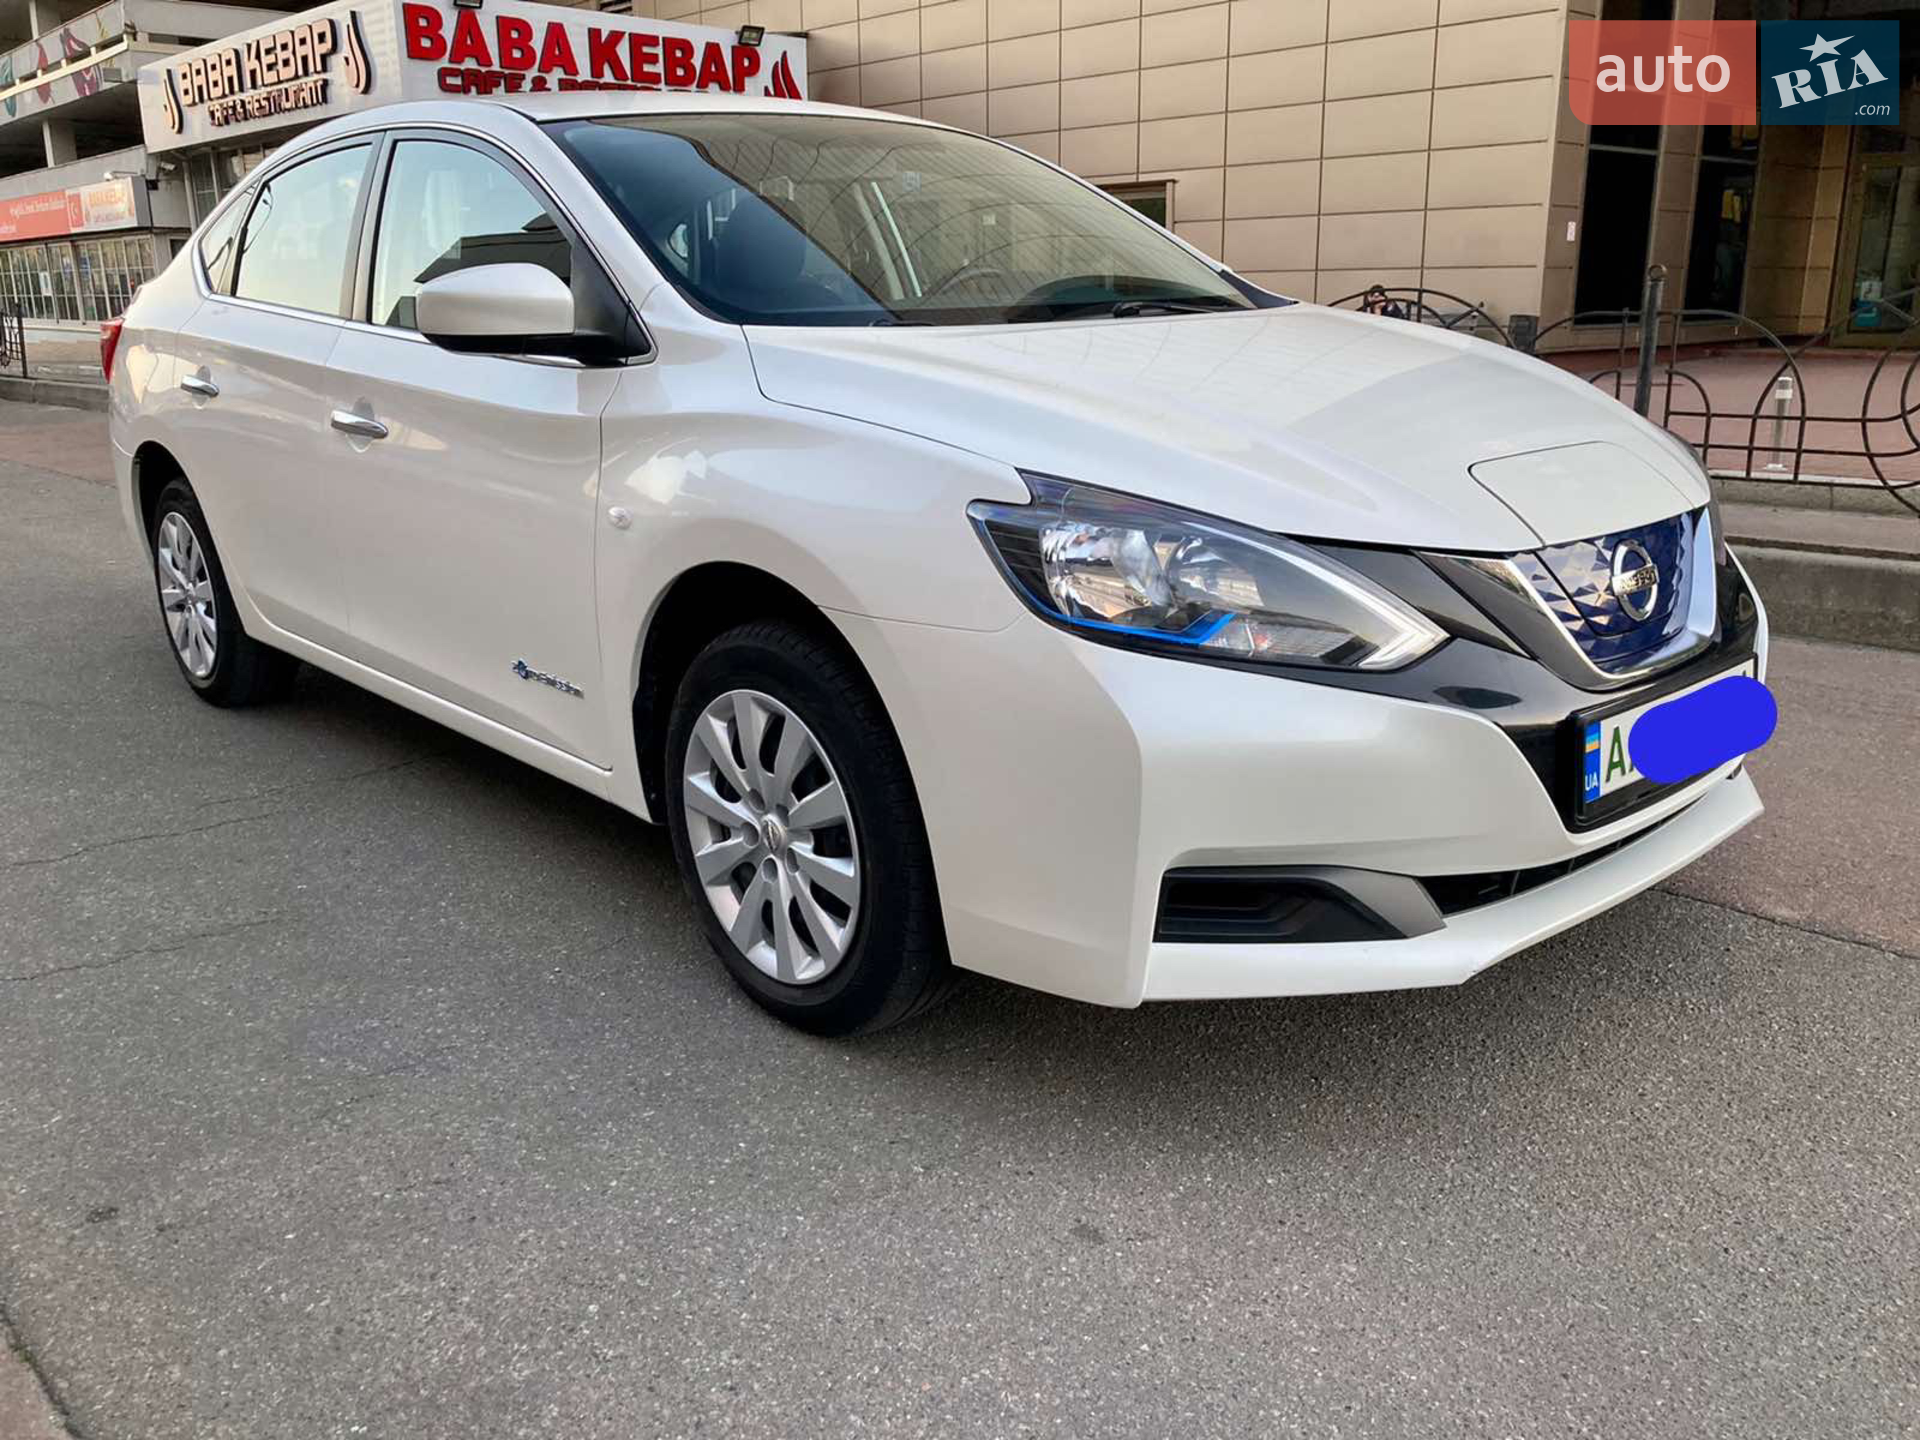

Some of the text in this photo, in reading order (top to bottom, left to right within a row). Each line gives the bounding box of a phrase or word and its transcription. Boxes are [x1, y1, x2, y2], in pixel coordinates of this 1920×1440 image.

[178, 18, 338, 107] BABA KEBAP
[402, 2, 762, 93] BABA KEBAP
[245, 77, 328, 119] RESTAURANT
[437, 67, 526, 94] CAFE
[1585, 772, 1598, 790] UA
